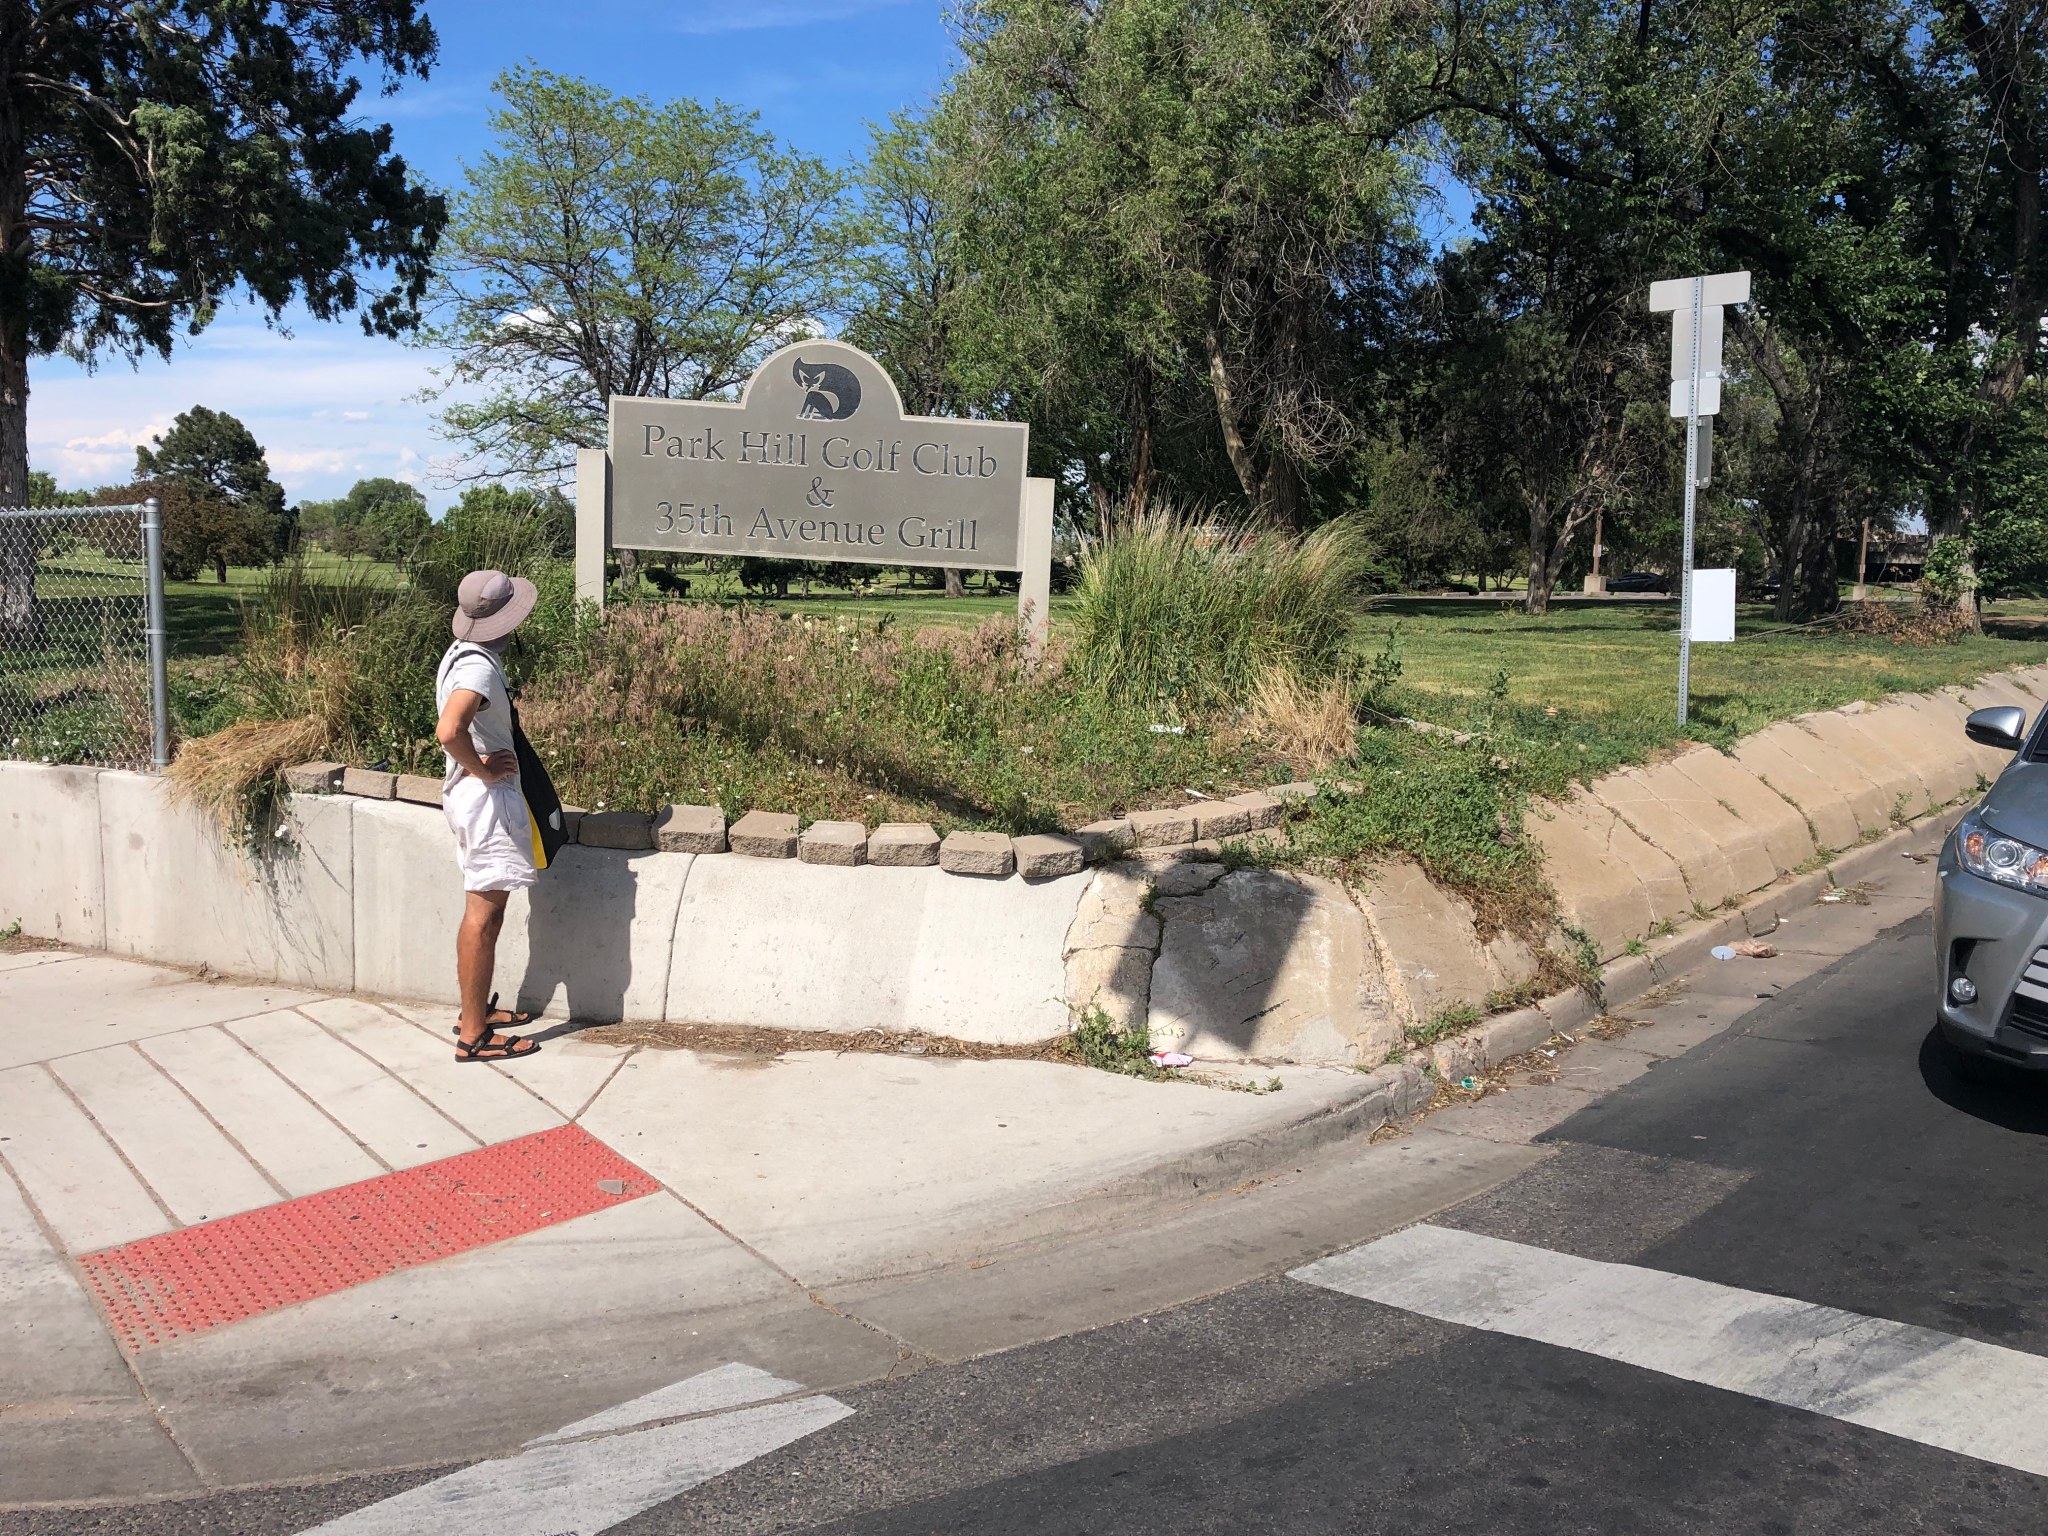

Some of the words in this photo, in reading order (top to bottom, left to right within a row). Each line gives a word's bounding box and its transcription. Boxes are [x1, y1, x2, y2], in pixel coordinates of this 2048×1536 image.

[641, 424, 726, 461] Park
[737, 431, 809, 467] Hill
[822, 437, 902, 473] Golf
[912, 443, 998, 479] Club
[805, 476, 835, 508] &
[655, 501, 734, 537] 35th
[747, 507, 885, 546] Avenue
[897, 516, 979, 552] Grill
